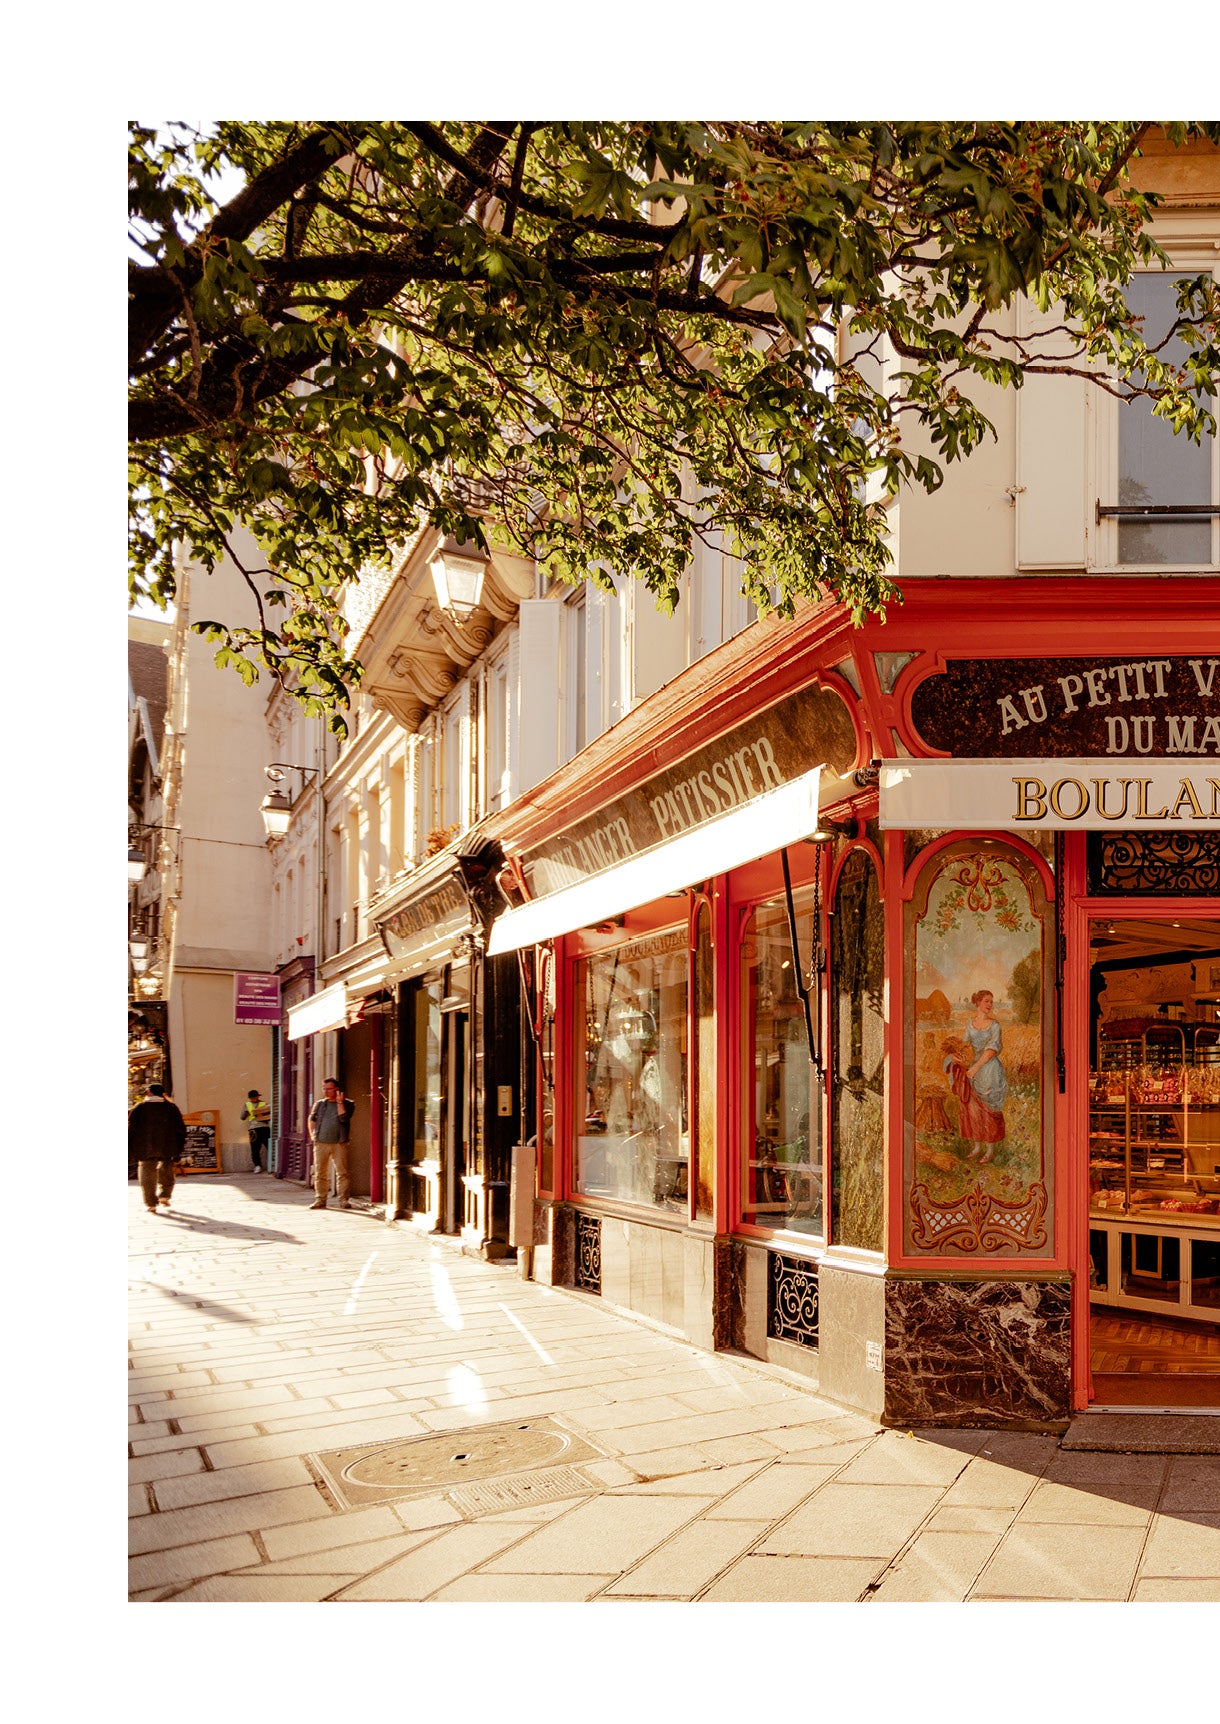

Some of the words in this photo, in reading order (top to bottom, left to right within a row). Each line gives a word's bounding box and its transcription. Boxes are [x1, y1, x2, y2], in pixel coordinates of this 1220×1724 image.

[996, 684, 1048, 736] AU
[1057, 659, 1172, 713] PETIT
[1104, 715, 1156, 754] DU
[649, 736, 787, 840] PATISSIER
